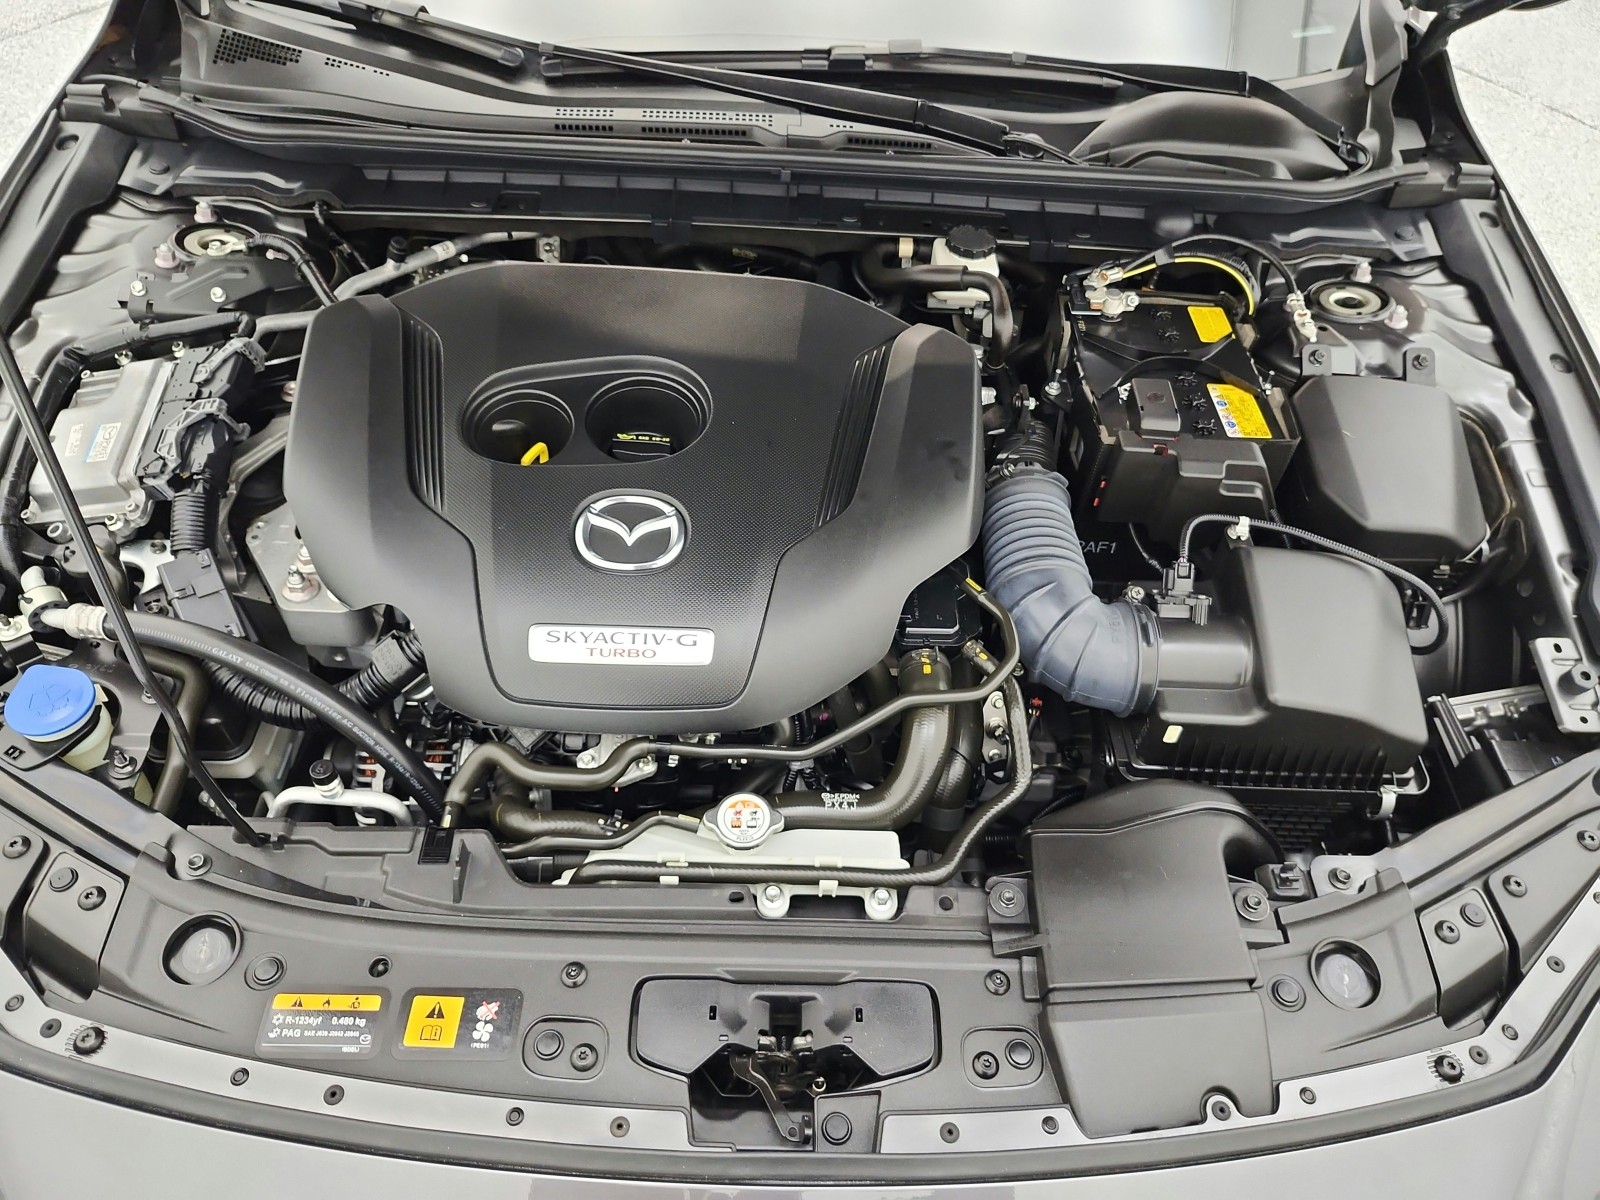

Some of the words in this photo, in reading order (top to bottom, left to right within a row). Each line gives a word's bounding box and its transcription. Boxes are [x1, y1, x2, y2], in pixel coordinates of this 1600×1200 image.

[545, 630, 698, 647] SKYACTIV-G
[586, 647, 657, 659] TURBO
[211, 647, 244, 665] GALAXY
[352, 724, 376, 747] SUCTION
[374, 743, 391, 759] HOSE
[285, 1015, 323, 1027] R-1234yf
[331, 1016, 355, 1026] 0.480
[355, 1017, 367, 1028] kg
[281, 1028, 301, 1038] PAG
